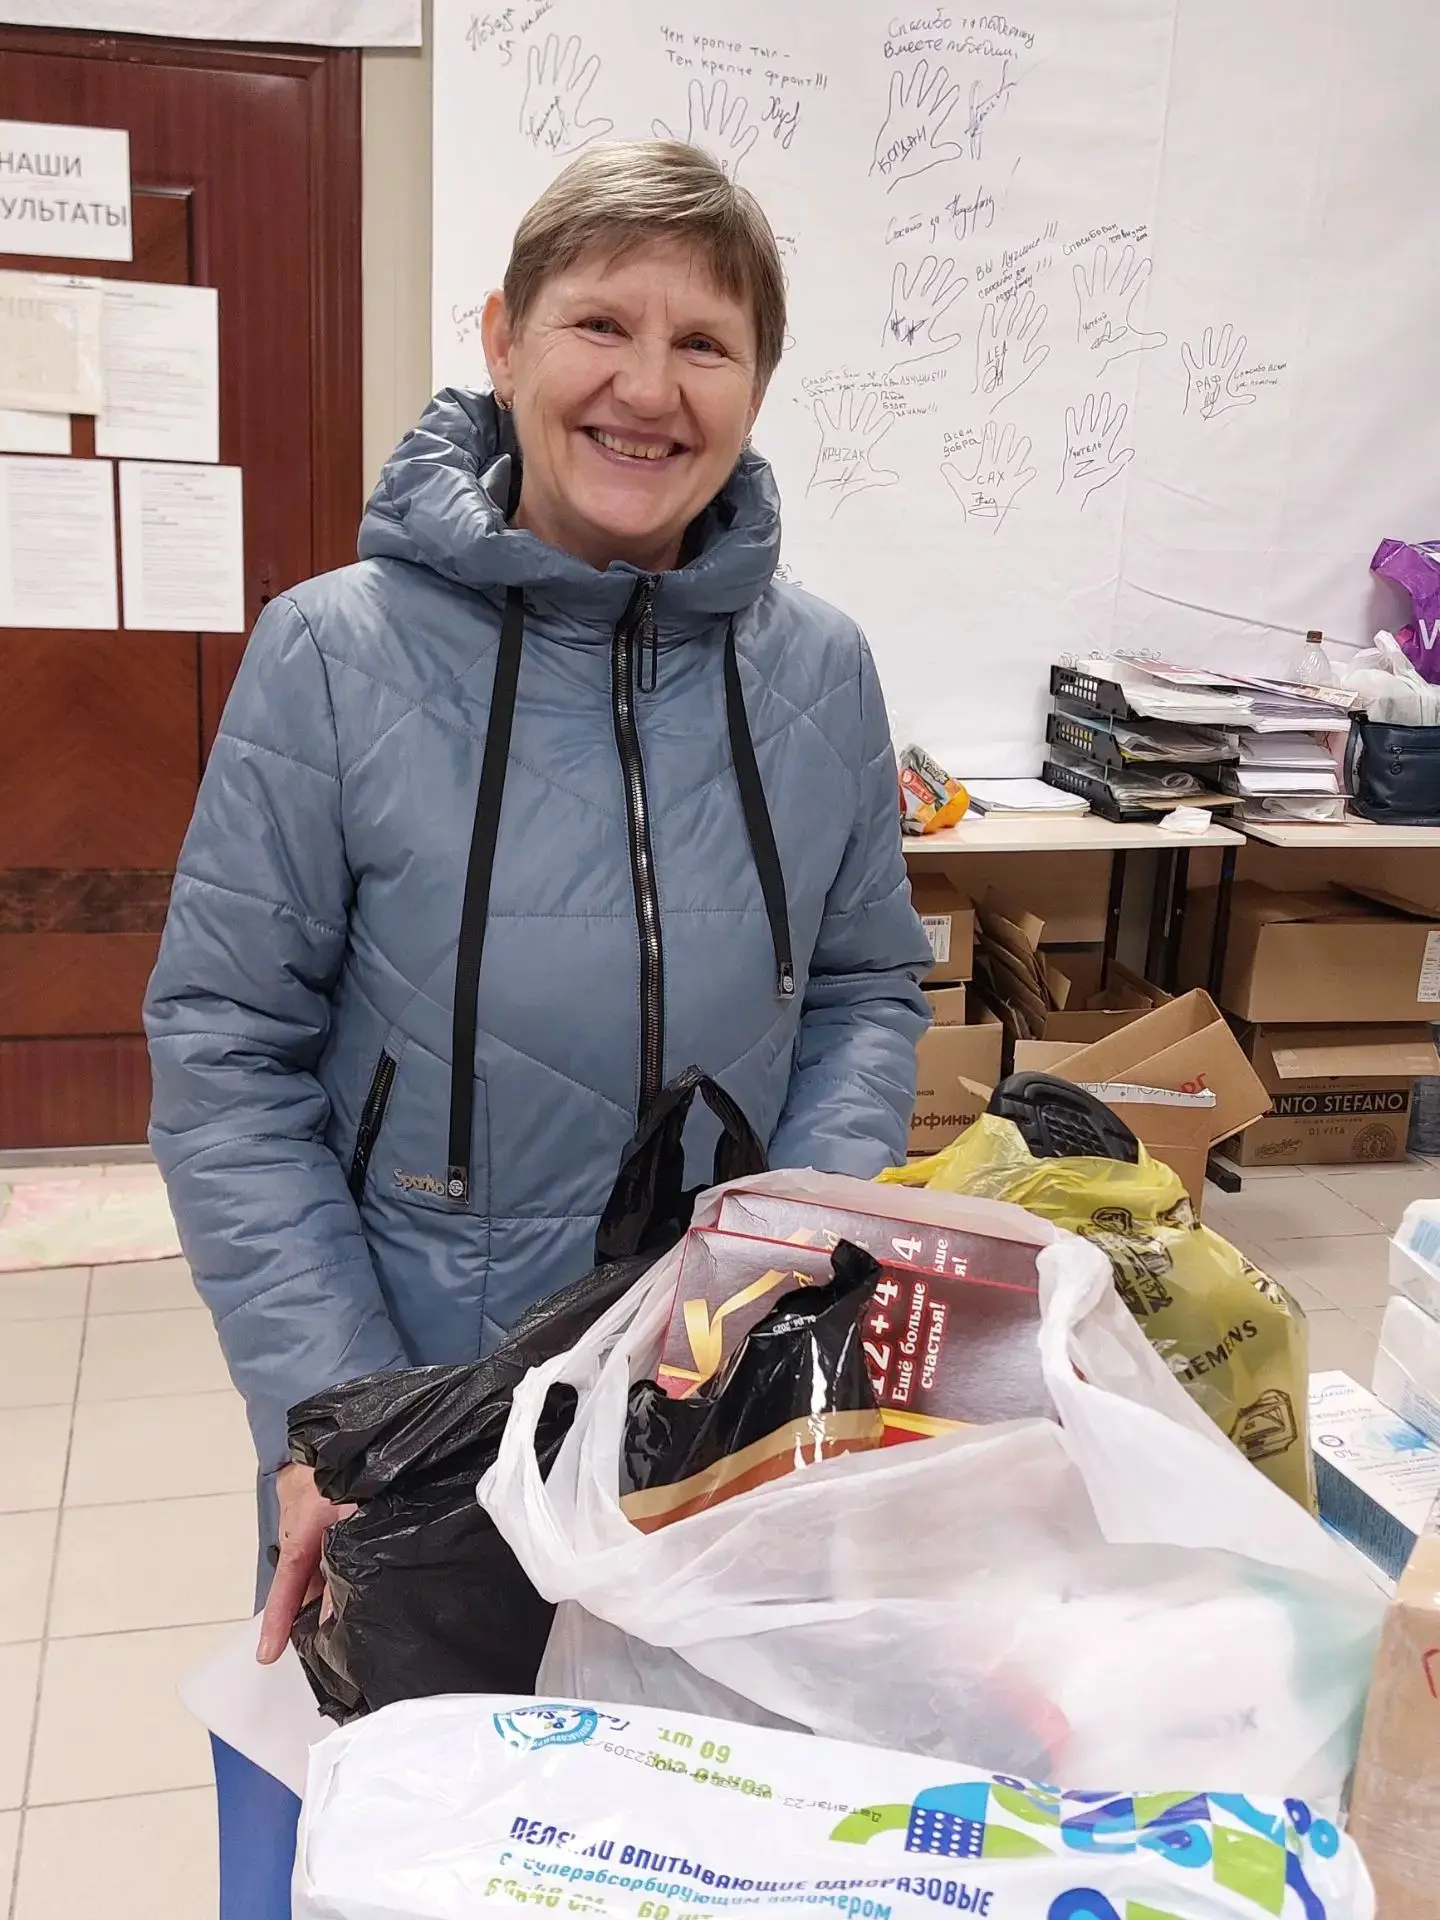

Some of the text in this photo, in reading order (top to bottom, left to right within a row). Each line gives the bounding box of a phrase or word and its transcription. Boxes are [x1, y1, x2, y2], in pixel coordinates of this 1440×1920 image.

[884, 38, 943, 59] Вместе
[701, 58, 753, 76] крепче
[0, 151, 82, 178] НАШИ
[1, 197, 127, 228] УЛЬТАТЫ
[1271, 1093, 1404, 1114] ANTO STEFANO
[911, 1112, 976, 1131] ффины
[891, 1282, 926, 1402] Ещё больше
[921, 1300, 947, 1390] счастья!
[1184, 1319, 1258, 1381] IEMENS
[700, 1740, 731, 1764] 60
[509, 1816, 995, 1917] ПЕЛЕИ ВПИТЫВАЮЩИЕ ОДНОРАЗОВЫЕ
